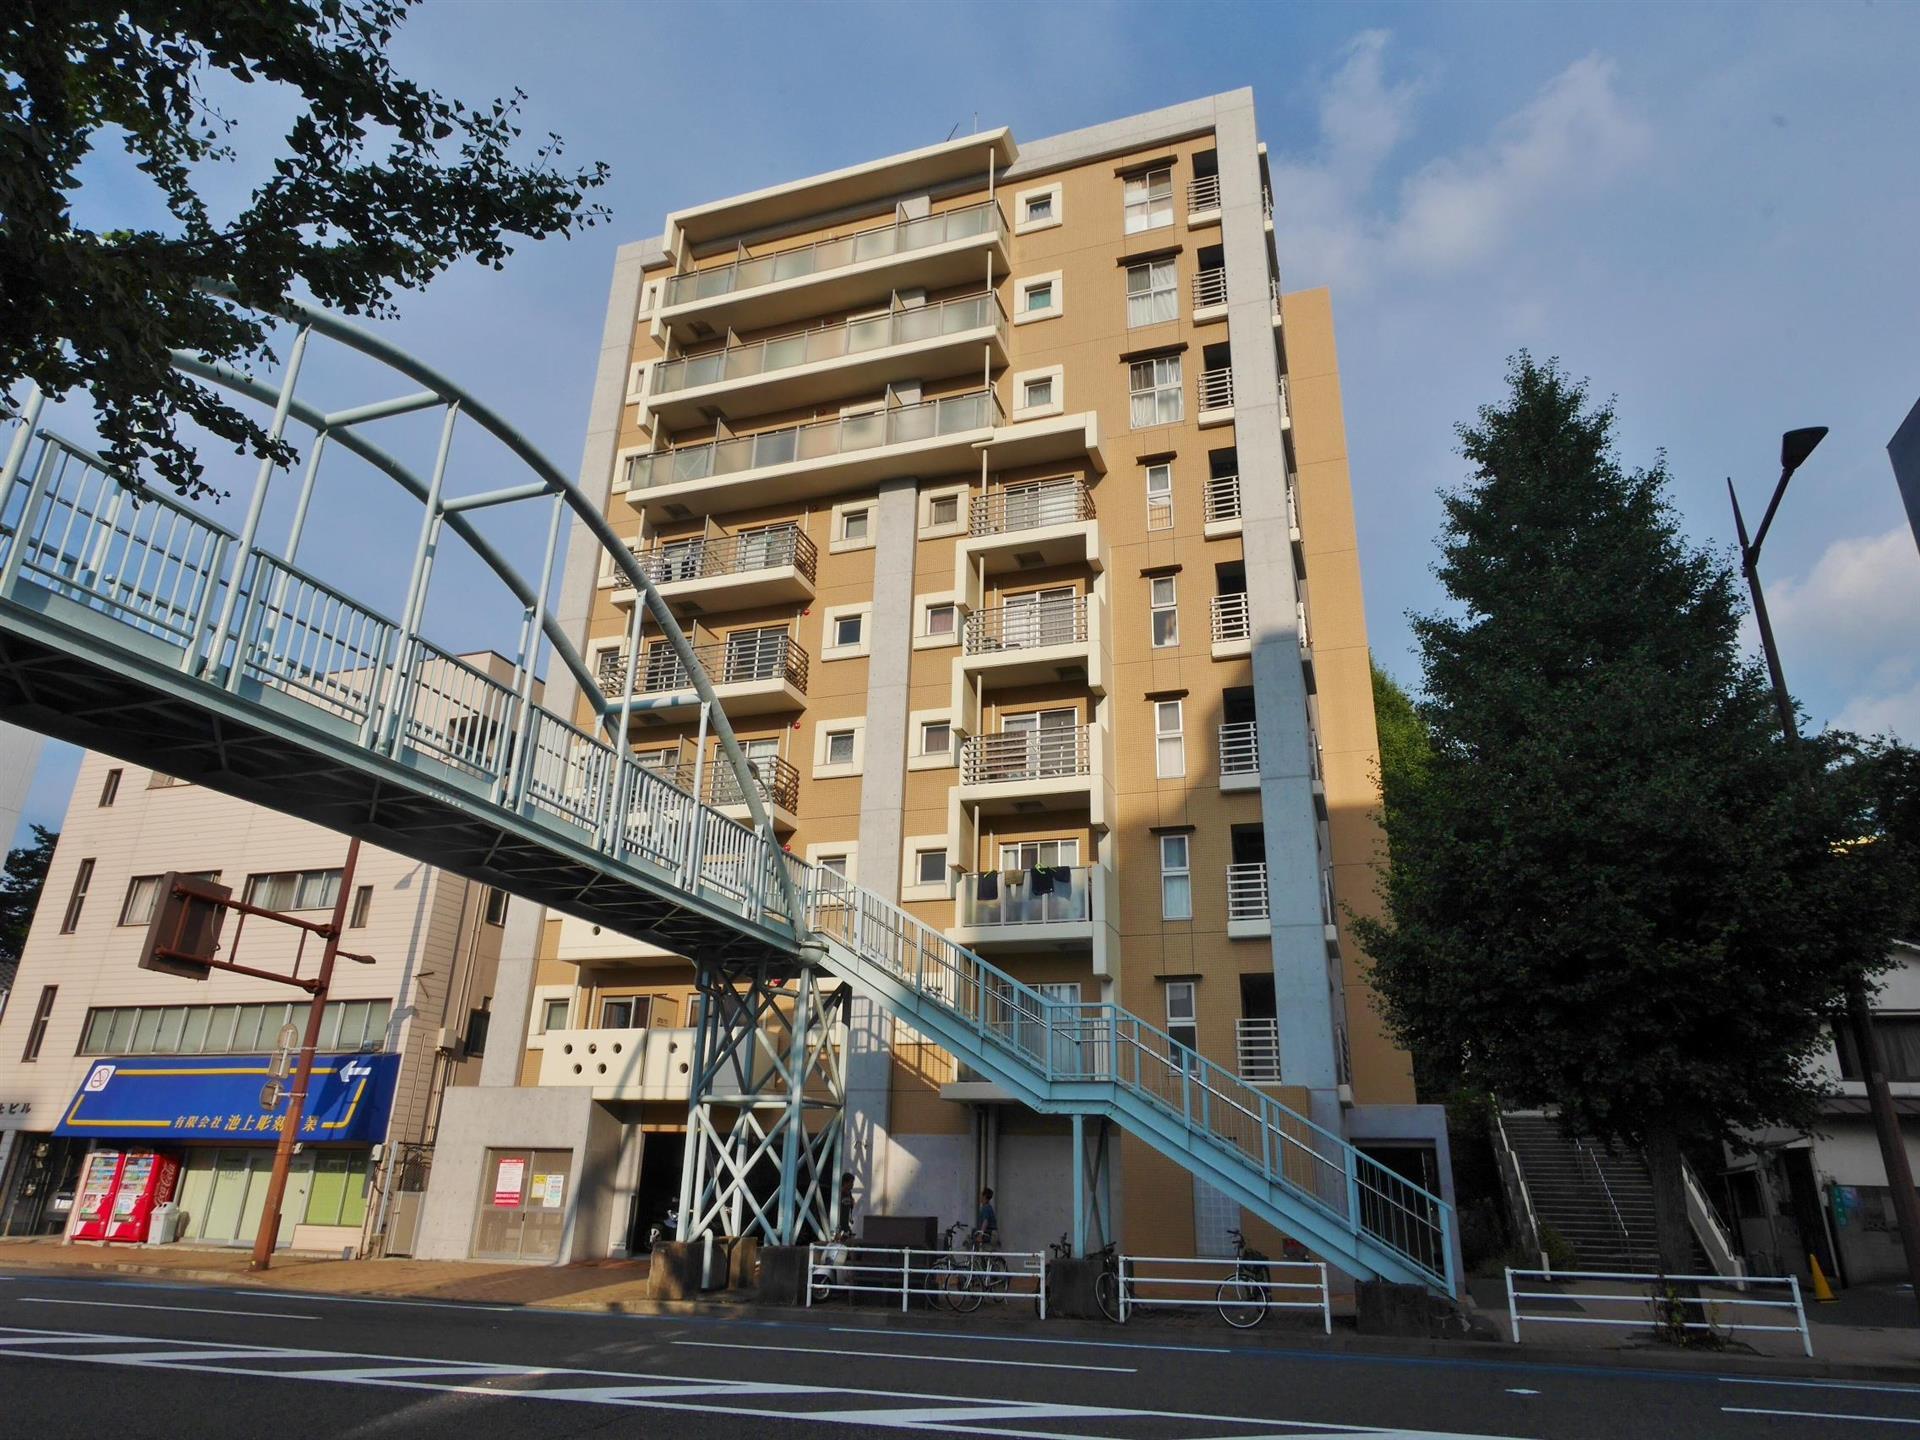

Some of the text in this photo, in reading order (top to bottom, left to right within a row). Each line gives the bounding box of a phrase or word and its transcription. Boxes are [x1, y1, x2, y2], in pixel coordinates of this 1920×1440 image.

[224, 1113, 320, 1132] 池上彫刻業
